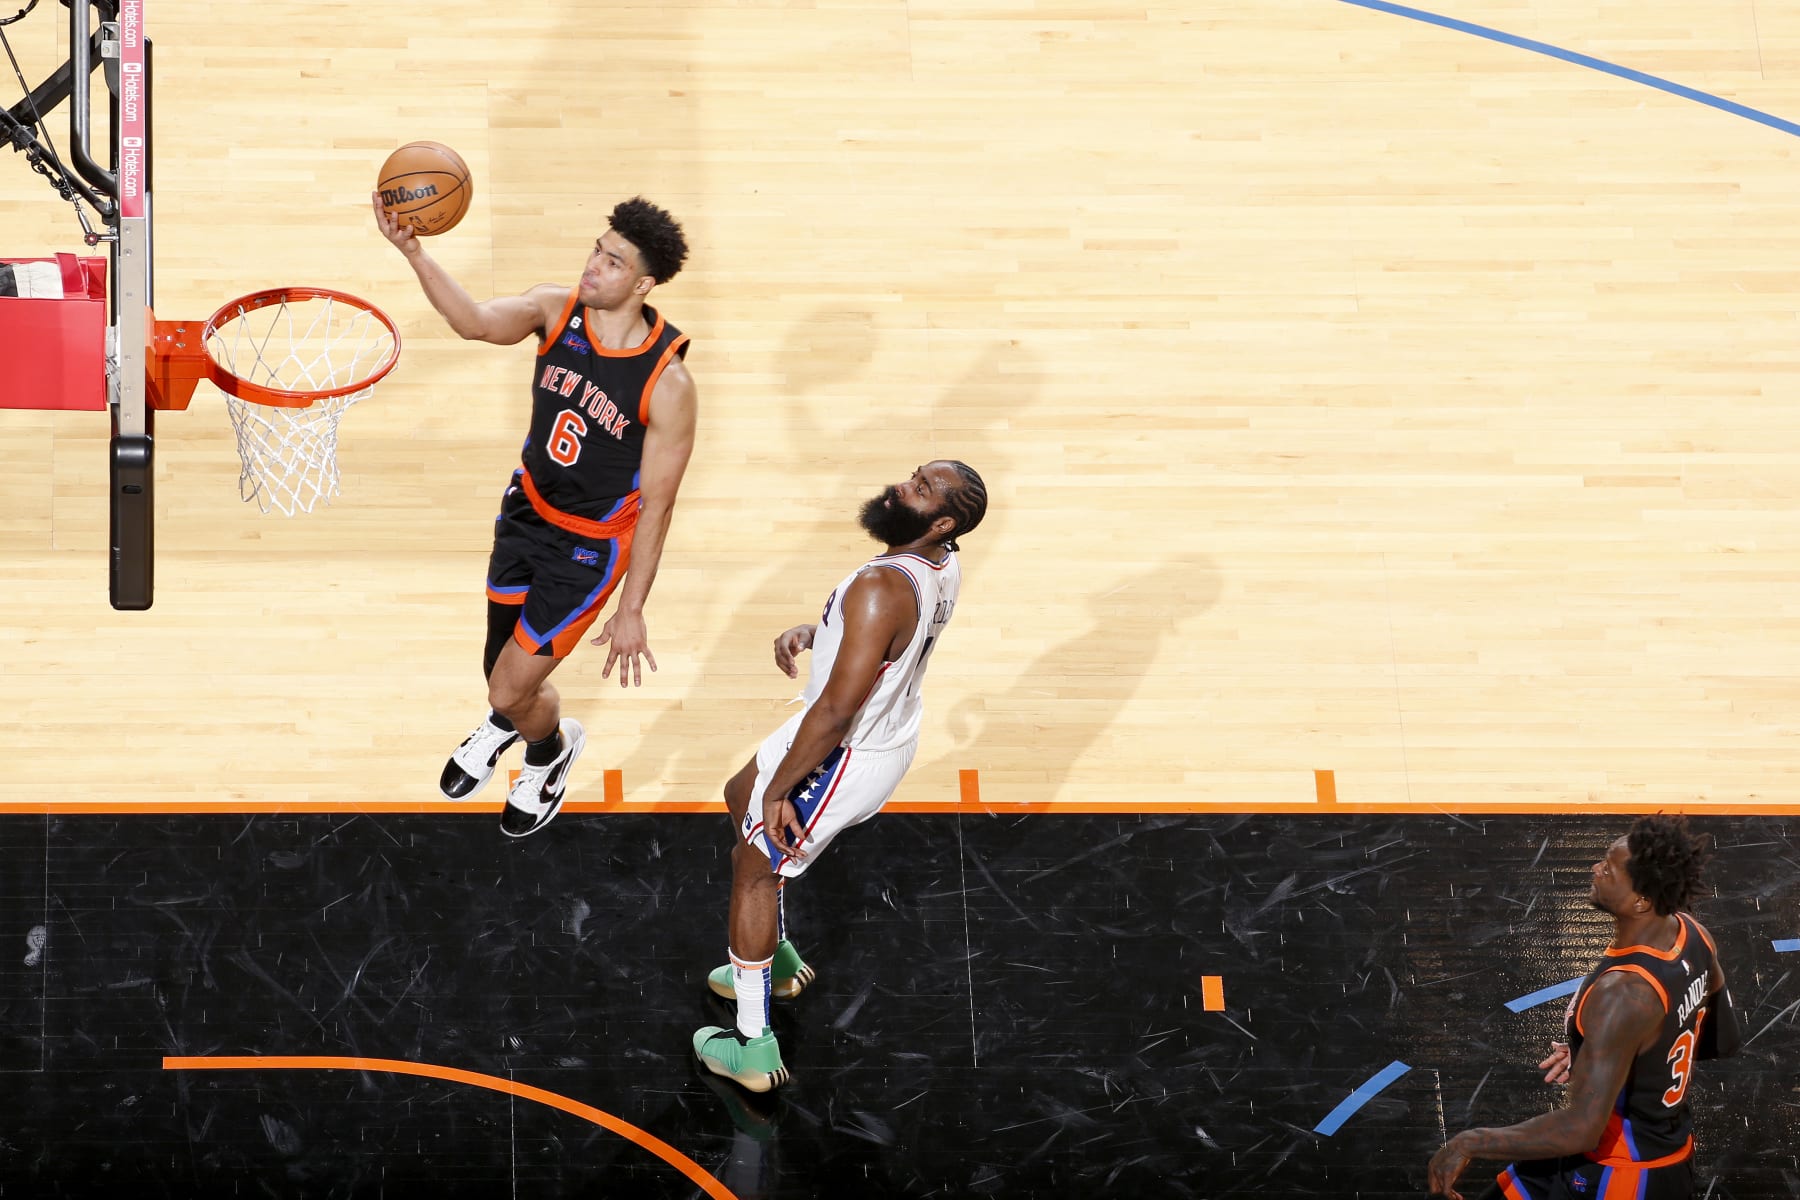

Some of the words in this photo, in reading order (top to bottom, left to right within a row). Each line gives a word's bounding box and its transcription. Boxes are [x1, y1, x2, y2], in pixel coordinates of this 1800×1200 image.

[124, 0, 141, 48] Hotels.com
[125, 73, 141, 122] Hotels.com
[124, 148, 141, 197] Hotels.com
[381, 184, 439, 207] Wilson
[570, 315, 582, 329] 6
[539, 364, 583, 398] NEW
[579, 380, 631, 440] YORK
[546, 408, 588, 467] 6
